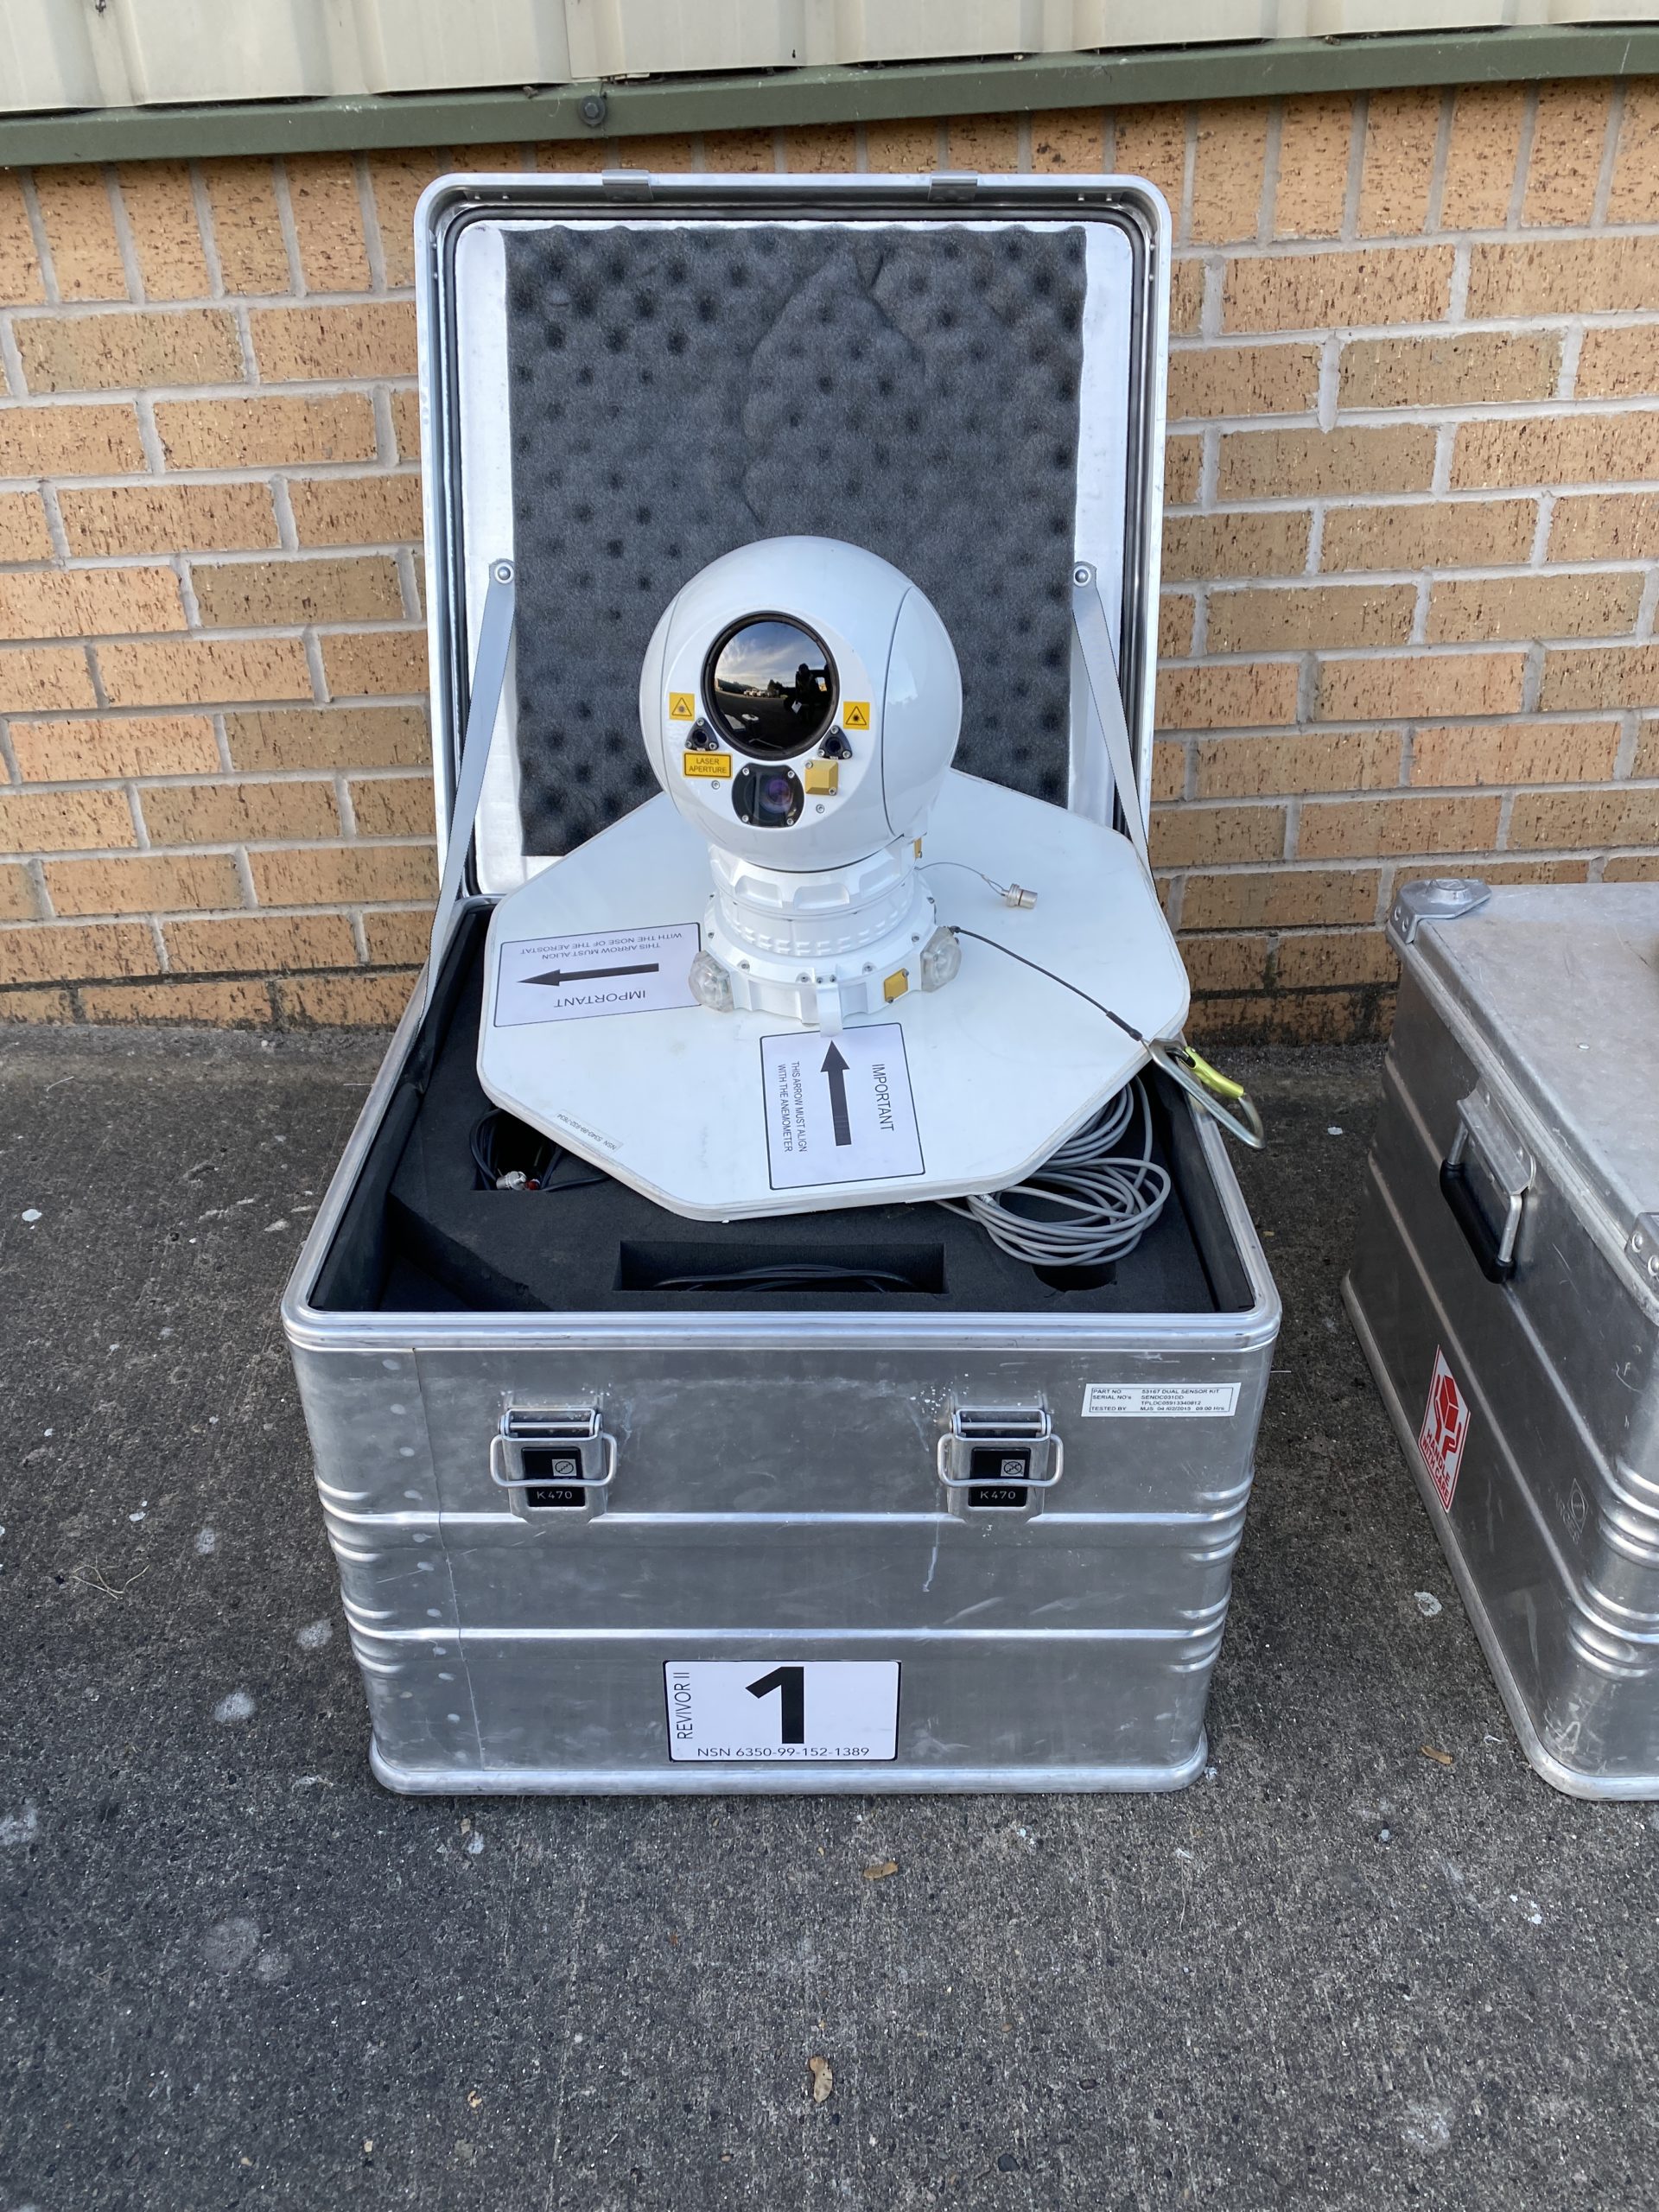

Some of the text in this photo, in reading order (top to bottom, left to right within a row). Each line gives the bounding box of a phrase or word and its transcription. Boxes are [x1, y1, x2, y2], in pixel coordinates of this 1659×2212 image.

[520, 943, 569, 954] AEROSTAT
[571, 947, 599, 957] MUST
[572, 941, 590, 950] THE
[601, 944, 637, 953] ARROW
[542, 950, 569, 960] ALIGN
[554, 990, 646, 1007] IMPORTANT
[872, 1064, 894, 1131] IMPORTANT
[778, 1064, 792, 1152] WITH THE ANEMOMETER
[791, 1061, 807, 1152] THIS ARROW MUST ALIGN
[1427, 1428, 1451, 1488] HANDLE
[1421, 1435, 1449, 1502] WITH CARE
[537, 1491, 573, 1500] K470
[980, 1491, 1016, 1500] K470
[674, 1683, 693, 1739] REVIVOR
[745, 1666, 804, 1744] 1
[697, 1747, 869, 1757] NSN 6350-99-152-1389
